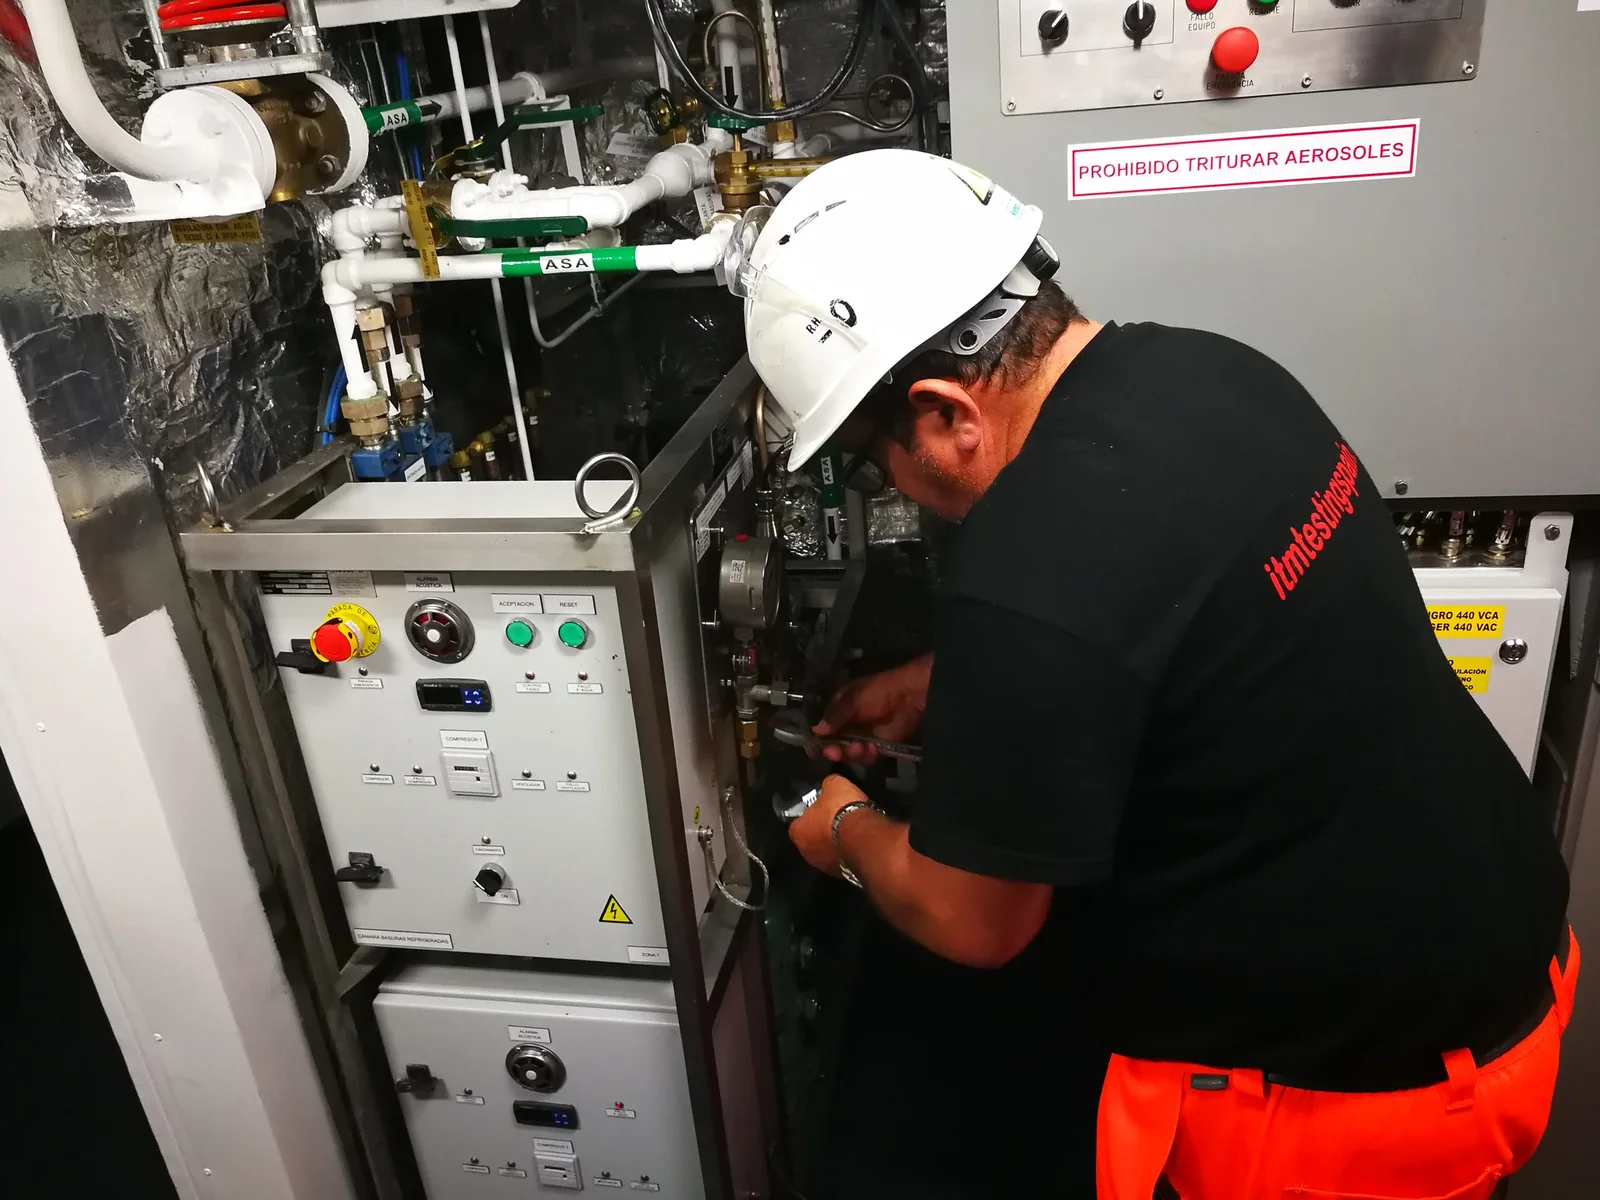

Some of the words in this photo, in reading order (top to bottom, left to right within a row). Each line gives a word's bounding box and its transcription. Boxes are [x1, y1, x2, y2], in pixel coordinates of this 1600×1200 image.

[1190, 12, 1214, 20] FALLO
[1188, 22, 1216, 31] EQUIPO
[387, 112, 407, 126] ASA
[1078, 158, 1180, 180] PROHIBIDO
[1185, 151, 1279, 172] TRITURAR
[1284, 142, 1404, 165] AEROSOLES
[545, 257, 589, 270] ASA
[822, 459, 831, 482] ASA
[327, 604, 353, 618] PARADA
[356, 608, 367, 617] DE
[1456, 611, 1475, 620] 440
[1478, 611, 1499, 620] VCA
[1453, 623, 1473, 632] 440
[1476, 623, 1497, 632] VAC
